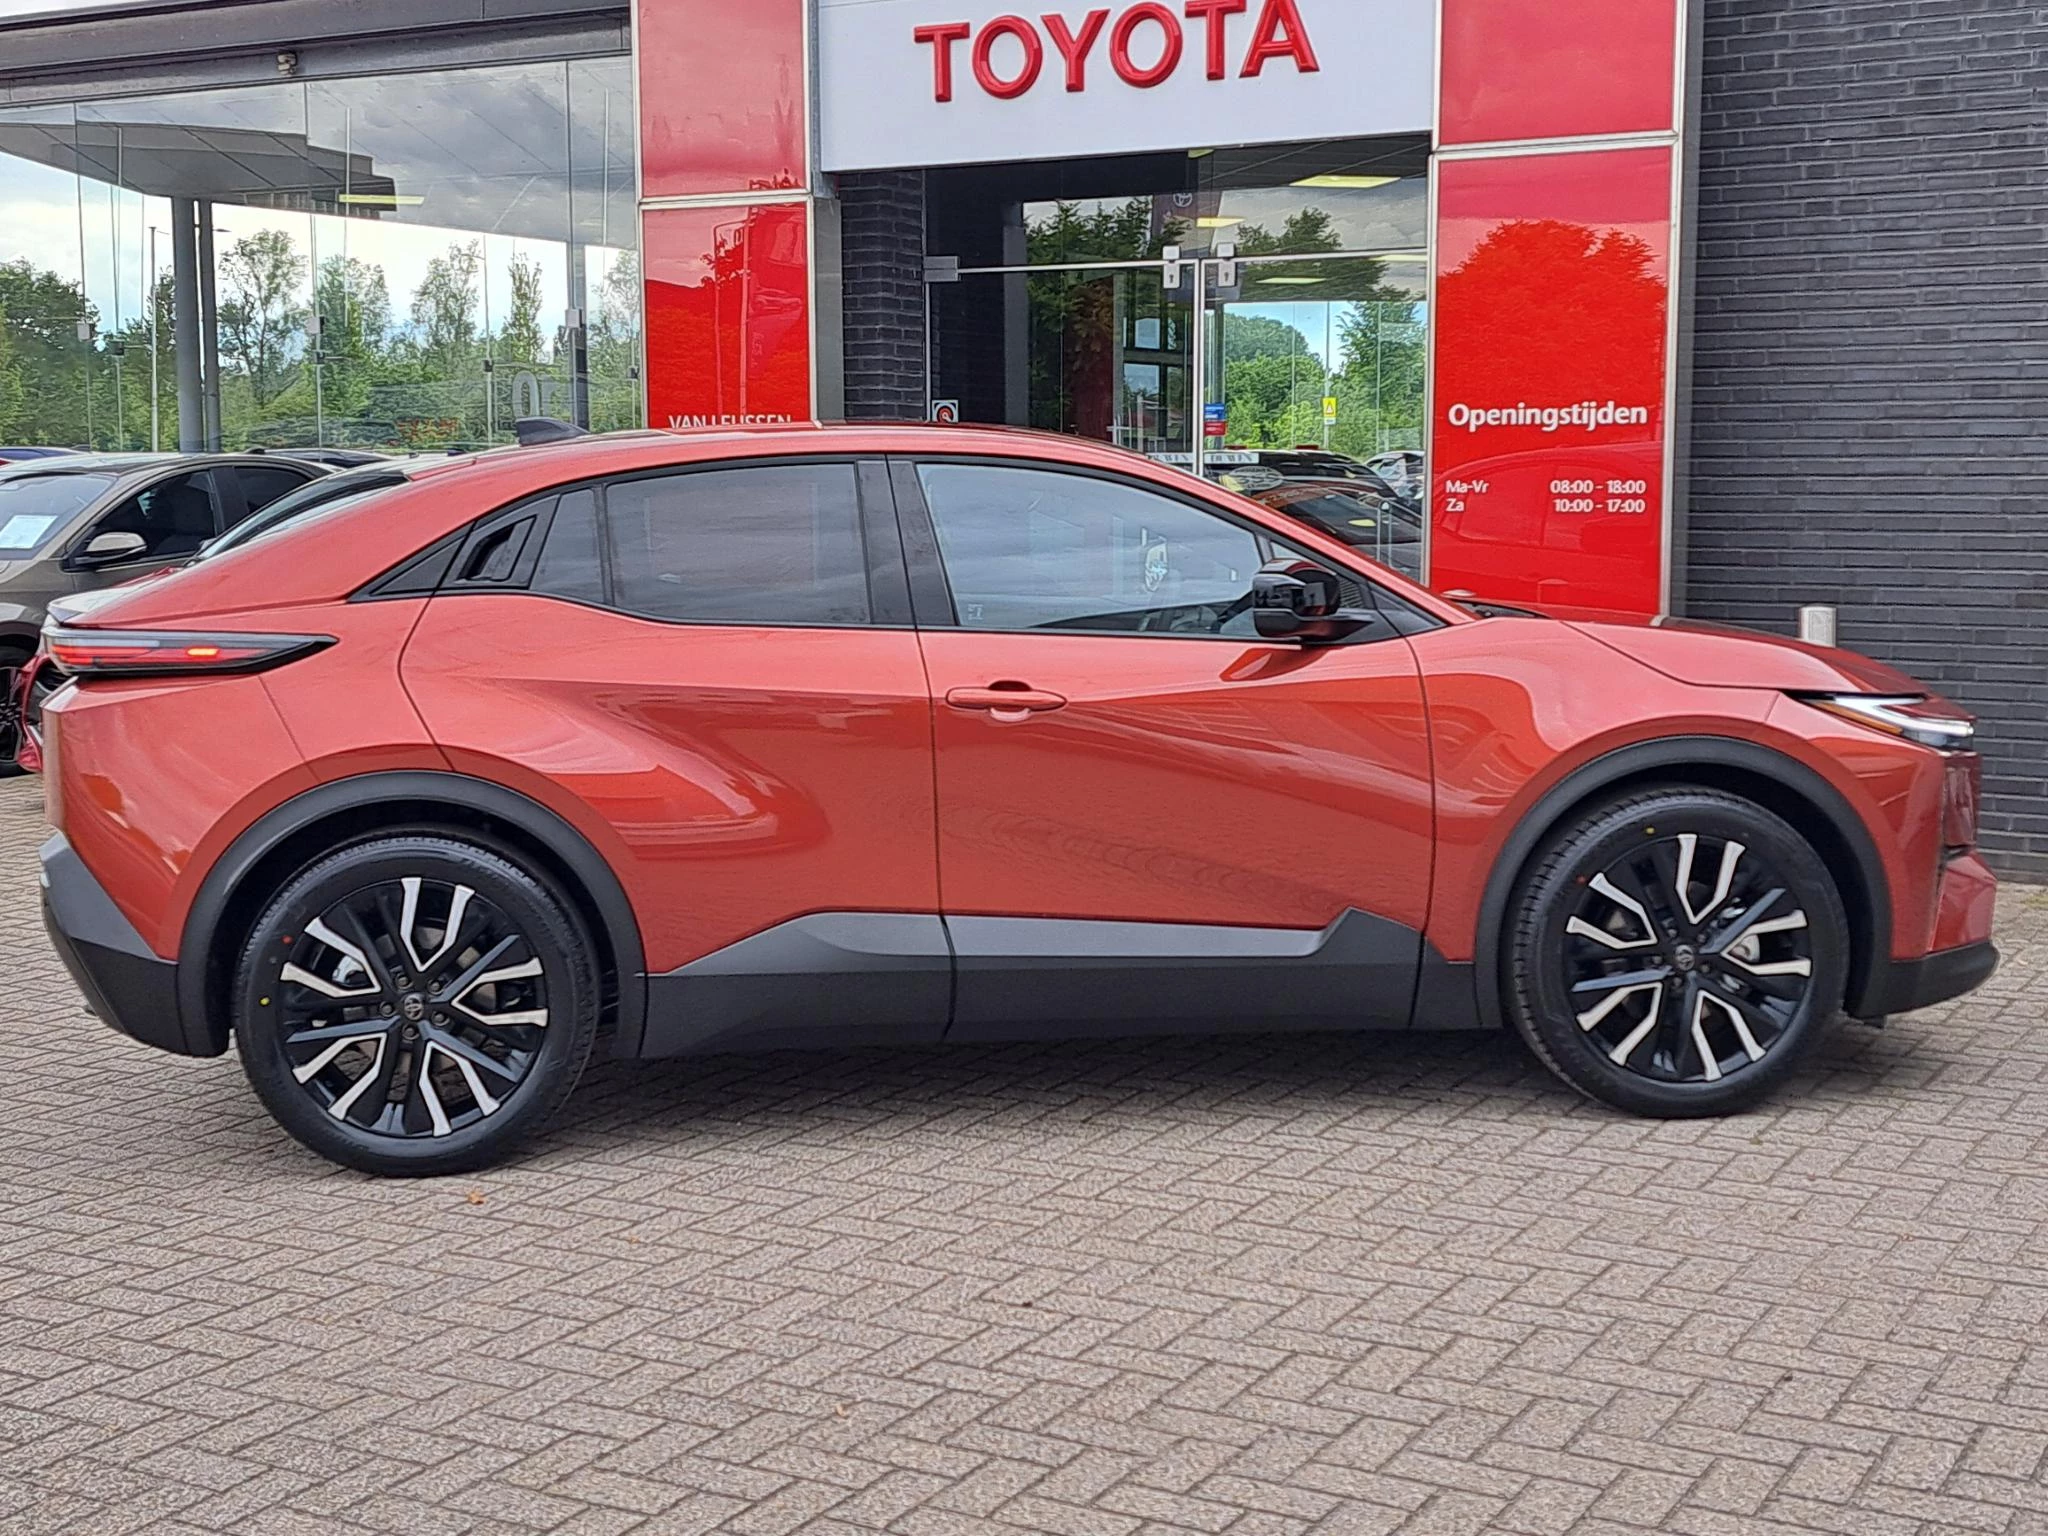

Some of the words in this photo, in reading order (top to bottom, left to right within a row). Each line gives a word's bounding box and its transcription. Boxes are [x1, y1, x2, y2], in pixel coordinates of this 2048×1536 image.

[914, 0, 1320, 103] TOYOTA
[668, 415, 706, 428] VAN
[1448, 401, 1648, 432] Openingstijden
[1445, 480, 1489, 494] Ma-Vr
[1550, 480, 1594, 494] 08:00
[1607, 480, 1647, 494] 18:00
[1445, 498, 1465, 512] Za
[1554, 499, 1594, 512] 10:00
[1607, 499, 1646, 512] 17:00
